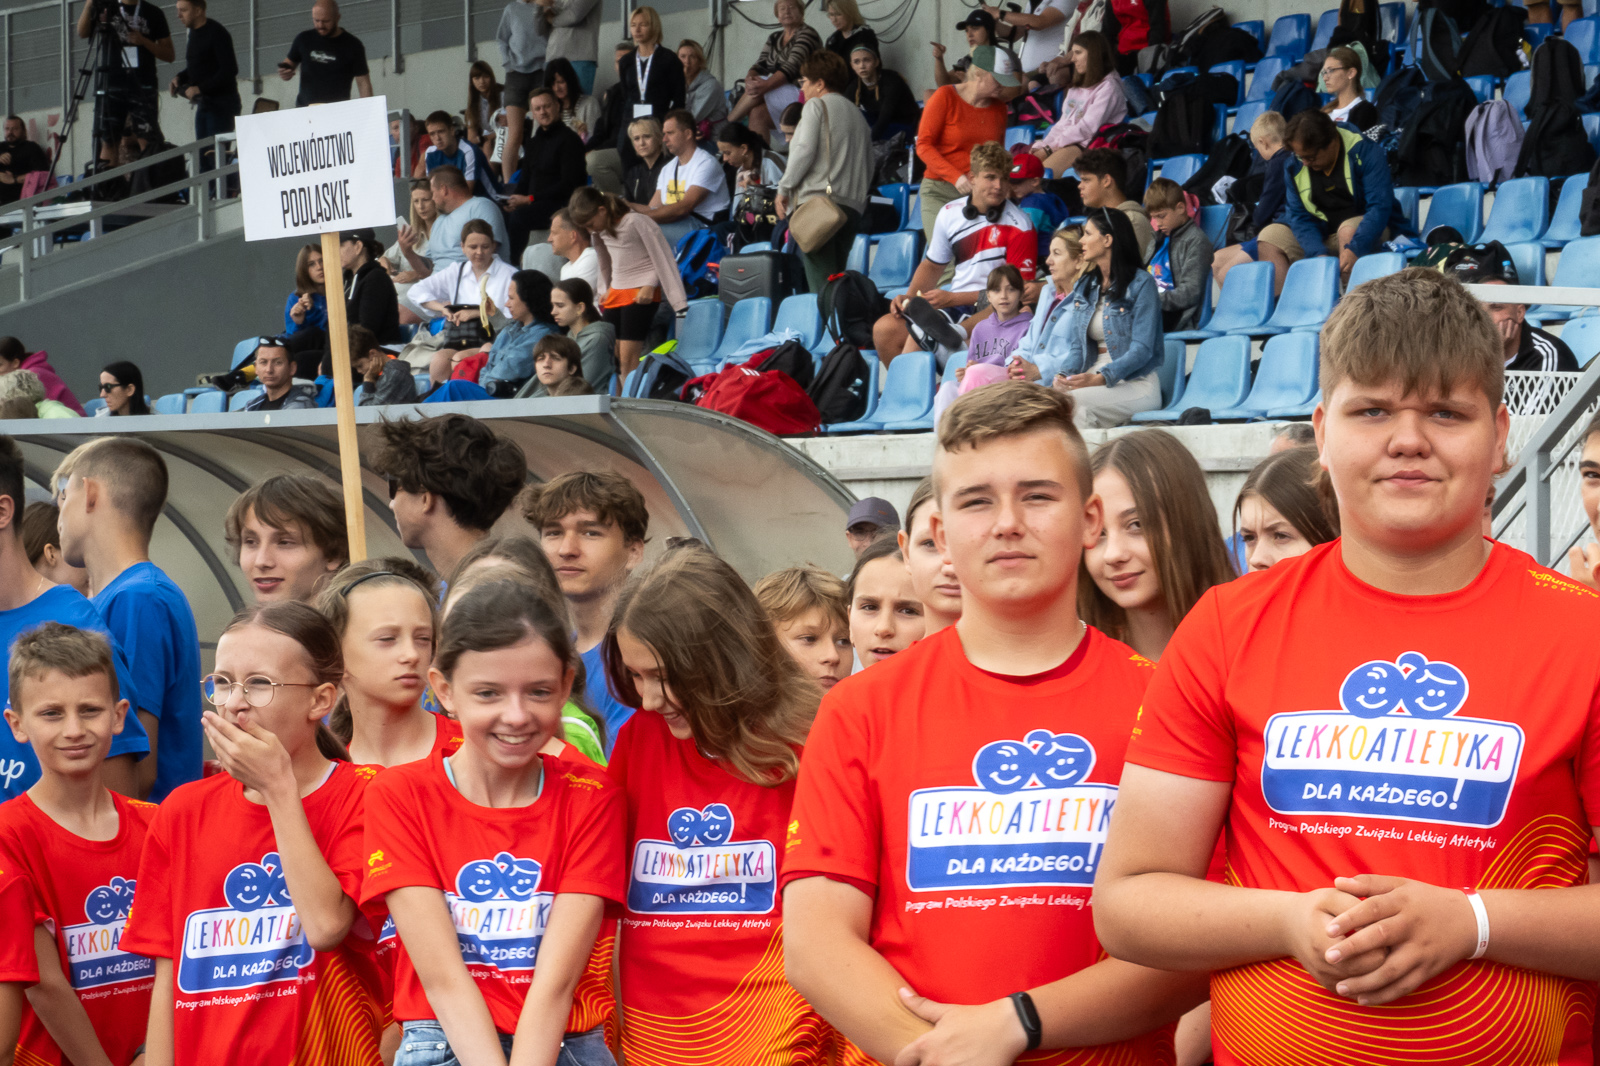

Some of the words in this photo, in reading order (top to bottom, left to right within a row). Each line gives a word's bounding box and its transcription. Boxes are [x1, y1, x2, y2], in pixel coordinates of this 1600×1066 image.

[267, 131, 355, 178] WOJEWÓDZTWO
[280, 179, 352, 229] PODLASKIE
[974, 337, 1019, 359] ALASK
[1276, 724, 1504, 771] LEKKOATLETYKA
[1302, 783, 1342, 800] DLA
[1348, 778, 1465, 810] KAŻDEGO!
[920, 797, 1116, 837] LEKKOATLETYK
[1269, 817, 1298, 833] Program
[1300, 822, 1352, 838] Polskiego
[1355, 825, 1404, 841] Związku
[1407, 829, 1447, 848] Lekkiej
[1449, 833, 1496, 851] Atletyki
[642, 849, 765, 879] LEKKOATLETYKA
[946, 857, 985, 875] DLA
[990, 842, 1099, 874] KAŻDEGO!
[652, 892, 676, 904] DLA
[679, 882, 747, 904] KAŻDEGO!
[944, 895, 997, 911] Polskiego
[1048, 893, 1086, 911] Lekkiej
[192, 912, 301, 950] LEKKOATLE
[652, 918, 684, 931] Polskiego
[713, 918, 740, 931] Lekkiej
[742, 918, 771, 930] Atletyki
[80, 966, 102, 980] DLA
[213, 964, 237, 979] DLA
[241, 955, 302, 977] KAŻDEGO
[175, 1000, 211, 1011] Program
[211, 995, 243, 1007] Polskiego
[277, 985, 297, 997] Lekk
